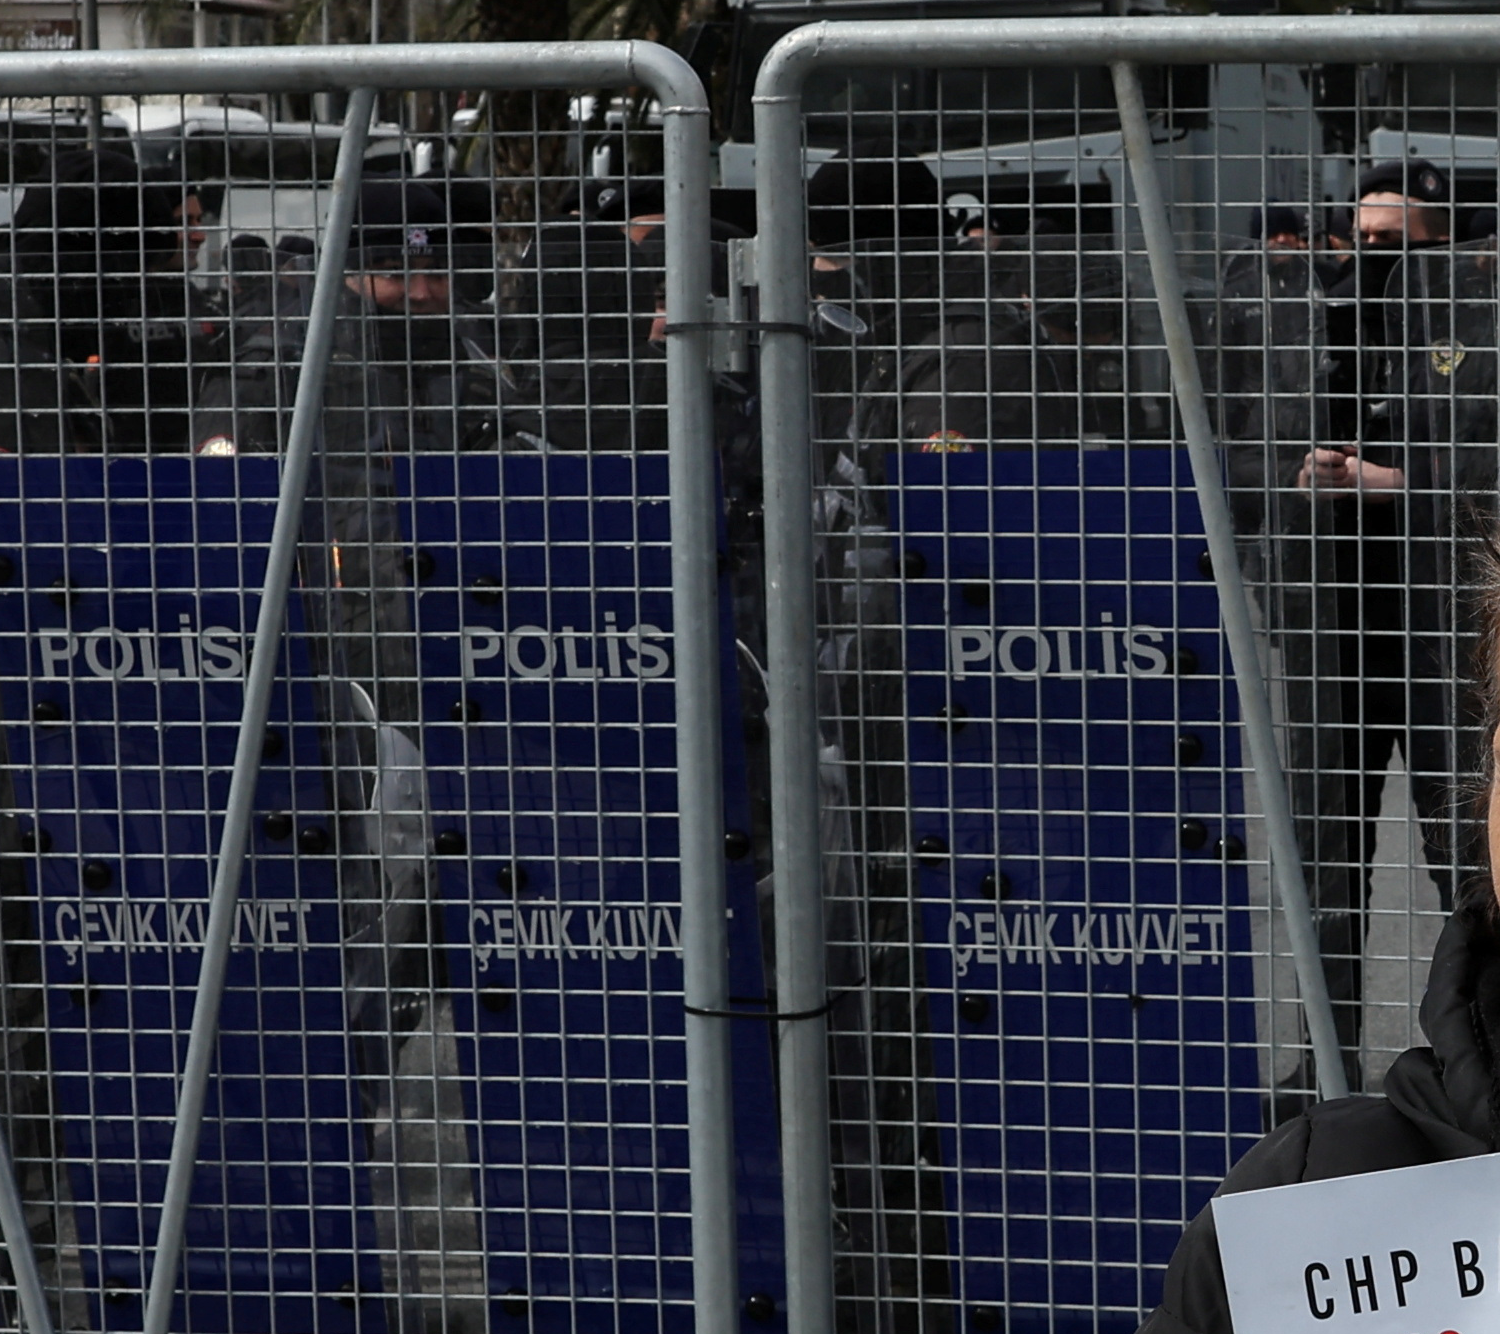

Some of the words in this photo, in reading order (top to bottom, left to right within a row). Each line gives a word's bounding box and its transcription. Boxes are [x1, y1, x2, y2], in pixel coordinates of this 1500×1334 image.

[38, 613, 245, 678] POLİS
[462, 611, 671, 678] POLİS
[950, 611, 1167, 681] POLİS
[55, 890, 164, 966] ÇEVİK
[468, 896, 579, 971] ÇEVİK
[948, 904, 1062, 976] ÇEVİK
[1072, 912, 1224, 966] KUVVET
[1304, 1248, 1419, 1321] CHP
